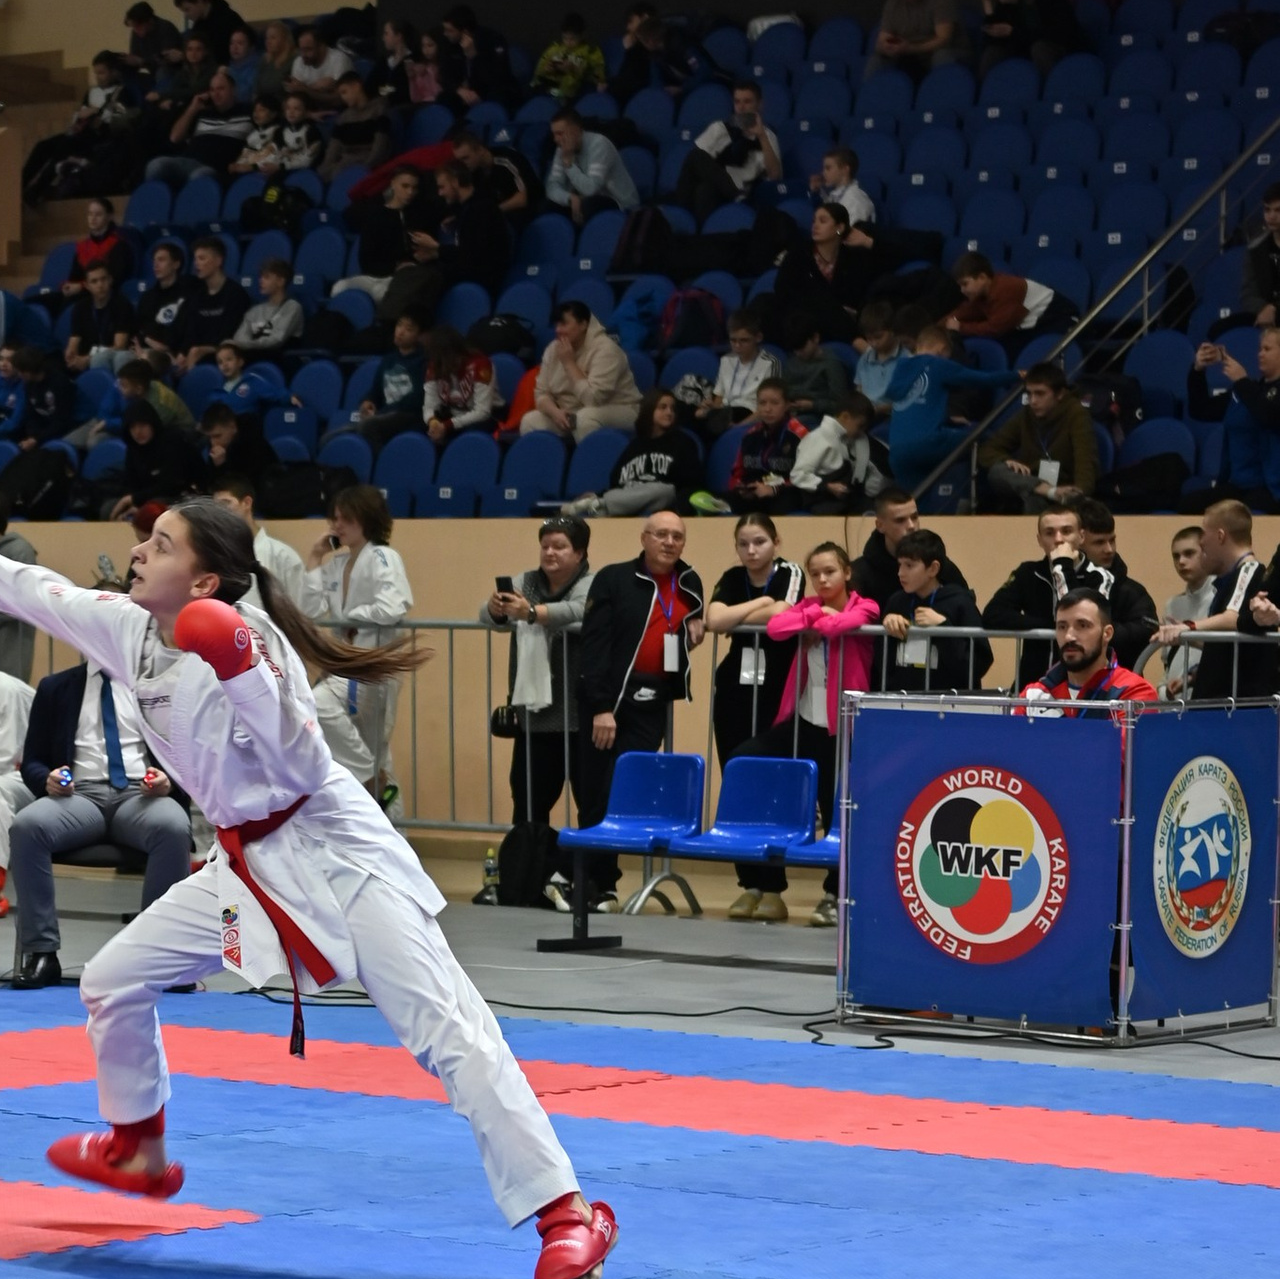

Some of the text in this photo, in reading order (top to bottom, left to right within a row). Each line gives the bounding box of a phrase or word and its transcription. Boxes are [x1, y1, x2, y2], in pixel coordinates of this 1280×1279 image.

[618, 453, 647, 485] NEW
[942, 769, 1023, 795] WORLD
[1158, 763, 1249, 849] ФЕДЕРАЦИЯ КАРАТЭ РОССИИ
[896, 821, 972, 961] FEDERATION
[938, 842, 1023, 879] WKF
[1034, 837, 1067, 934] KARATE
[1157, 869, 1246, 954] KARATE FEDERATION OF RUSSIA
